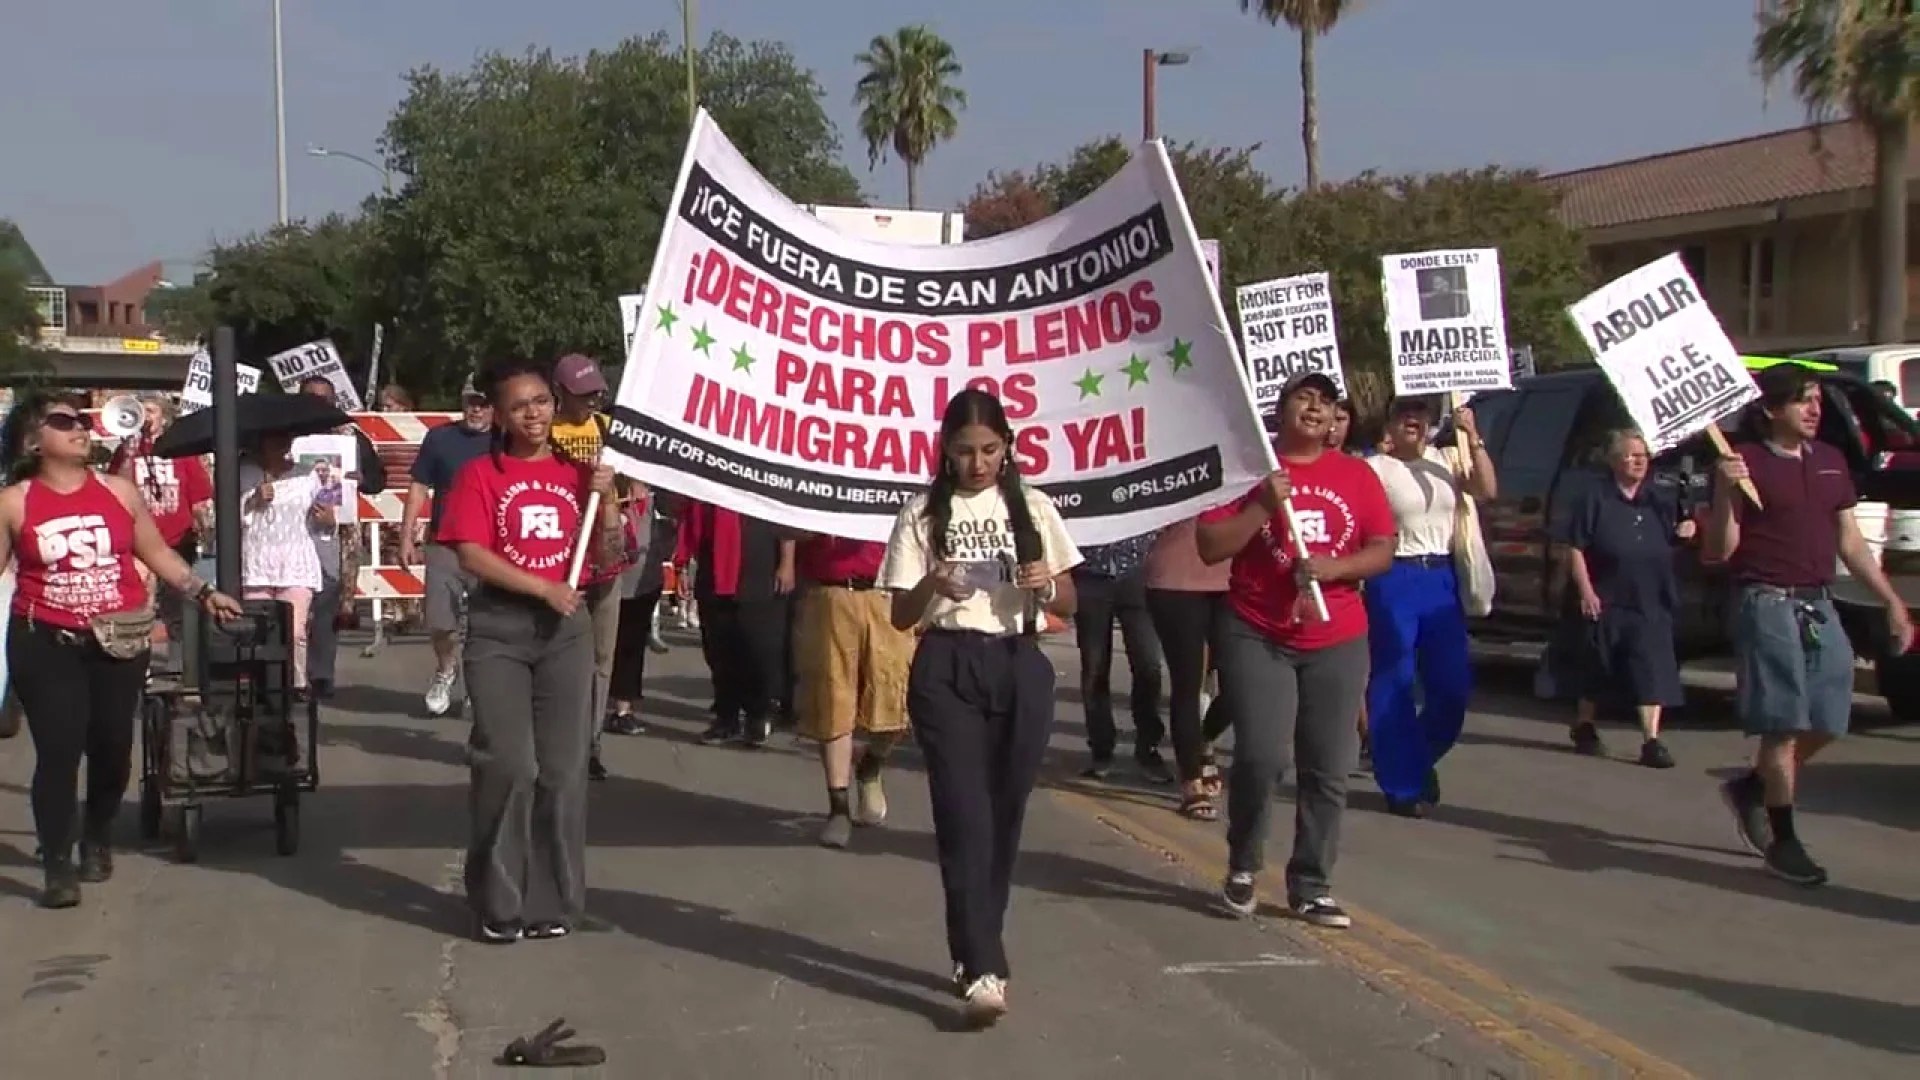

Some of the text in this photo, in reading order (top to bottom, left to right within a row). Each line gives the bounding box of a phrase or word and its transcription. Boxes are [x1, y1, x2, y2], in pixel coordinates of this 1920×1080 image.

[690, 186, 1160, 307] ¡ICE FUERA DE SAN ANTONIO!
[1400, 256, 1440, 270] DONDE
[684, 248, 951, 366] ¡DERECHOS
[968, 280, 1161, 368] PLENOS
[1240, 282, 1324, 310] MONEY FOR
[1591, 277, 1697, 352] ABOLIR
[1248, 314, 1327, 346] NOT FOR
[1400, 326, 1495, 352] MADRE
[277, 346, 330, 376] NO TO
[1253, 345, 1334, 382] RACIST
[1398, 350, 1501, 366] DESAPARECIDA
[1645, 343, 1712, 390] I.C.E.
[188, 371, 209, 391] FO
[775, 350, 915, 418] PARA
[1651, 362, 1737, 424] AHORA
[683, 373, 1147, 476] INMIGRANS YA!
[609, 419, 914, 505] PARTY FOR SOCIALISM AND LIBERAT
[1111, 462, 1211, 504] @PSLSATX
[521, 509, 565, 539] PSL
[947, 519, 997, 536] SOLO
[37, 526, 118, 570] PSL
[950, 533, 1014, 553] PUEBL
